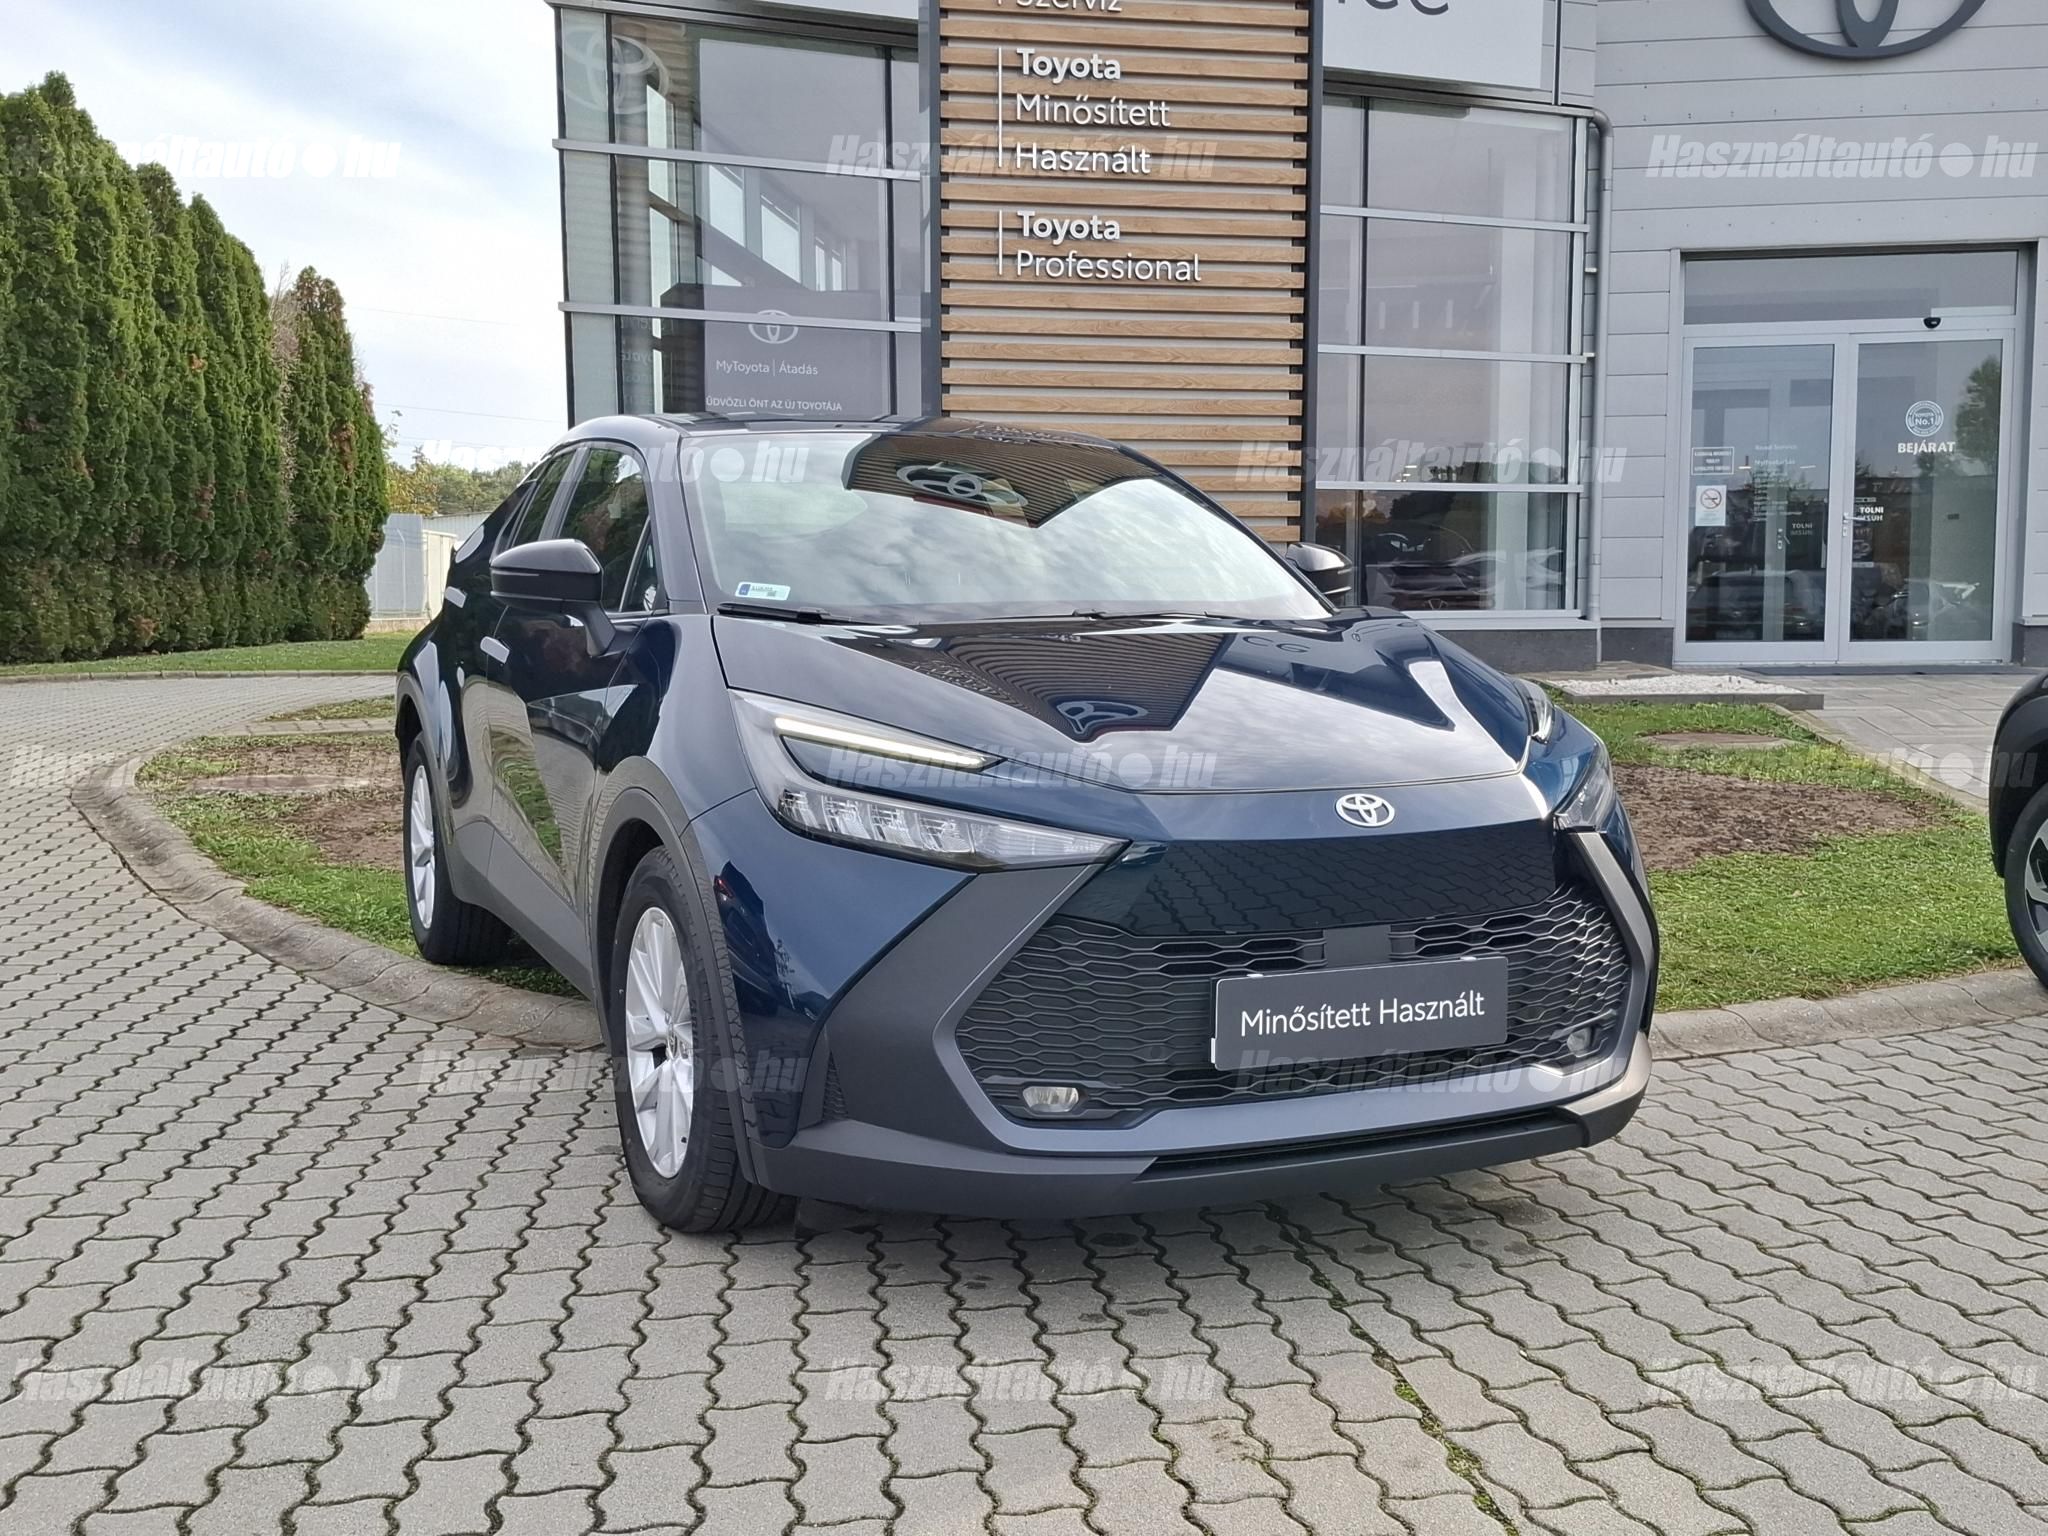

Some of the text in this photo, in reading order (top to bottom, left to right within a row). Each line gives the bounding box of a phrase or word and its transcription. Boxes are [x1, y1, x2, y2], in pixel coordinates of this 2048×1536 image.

[1016, 47, 1121, 84] Toyota
[1016, 93, 1171, 127] Minősített
[1016, 142, 1151, 174] Használt
[1017, 210, 1120, 246] Toyota
[1017, 249, 1202, 281] Professional
[716, 359, 818, 375] MyToyota Átadás
[770, 399, 784, 409] AZ
[797, 399, 842, 412] TOYOTÁJA
[1915, 417, 1934, 426] No.1
[1897, 439, 1956, 455] BEJÁRAT
[1859, 506, 1884, 514] TOLNI
[1240, 990, 1485, 1037] Minősített Használt
